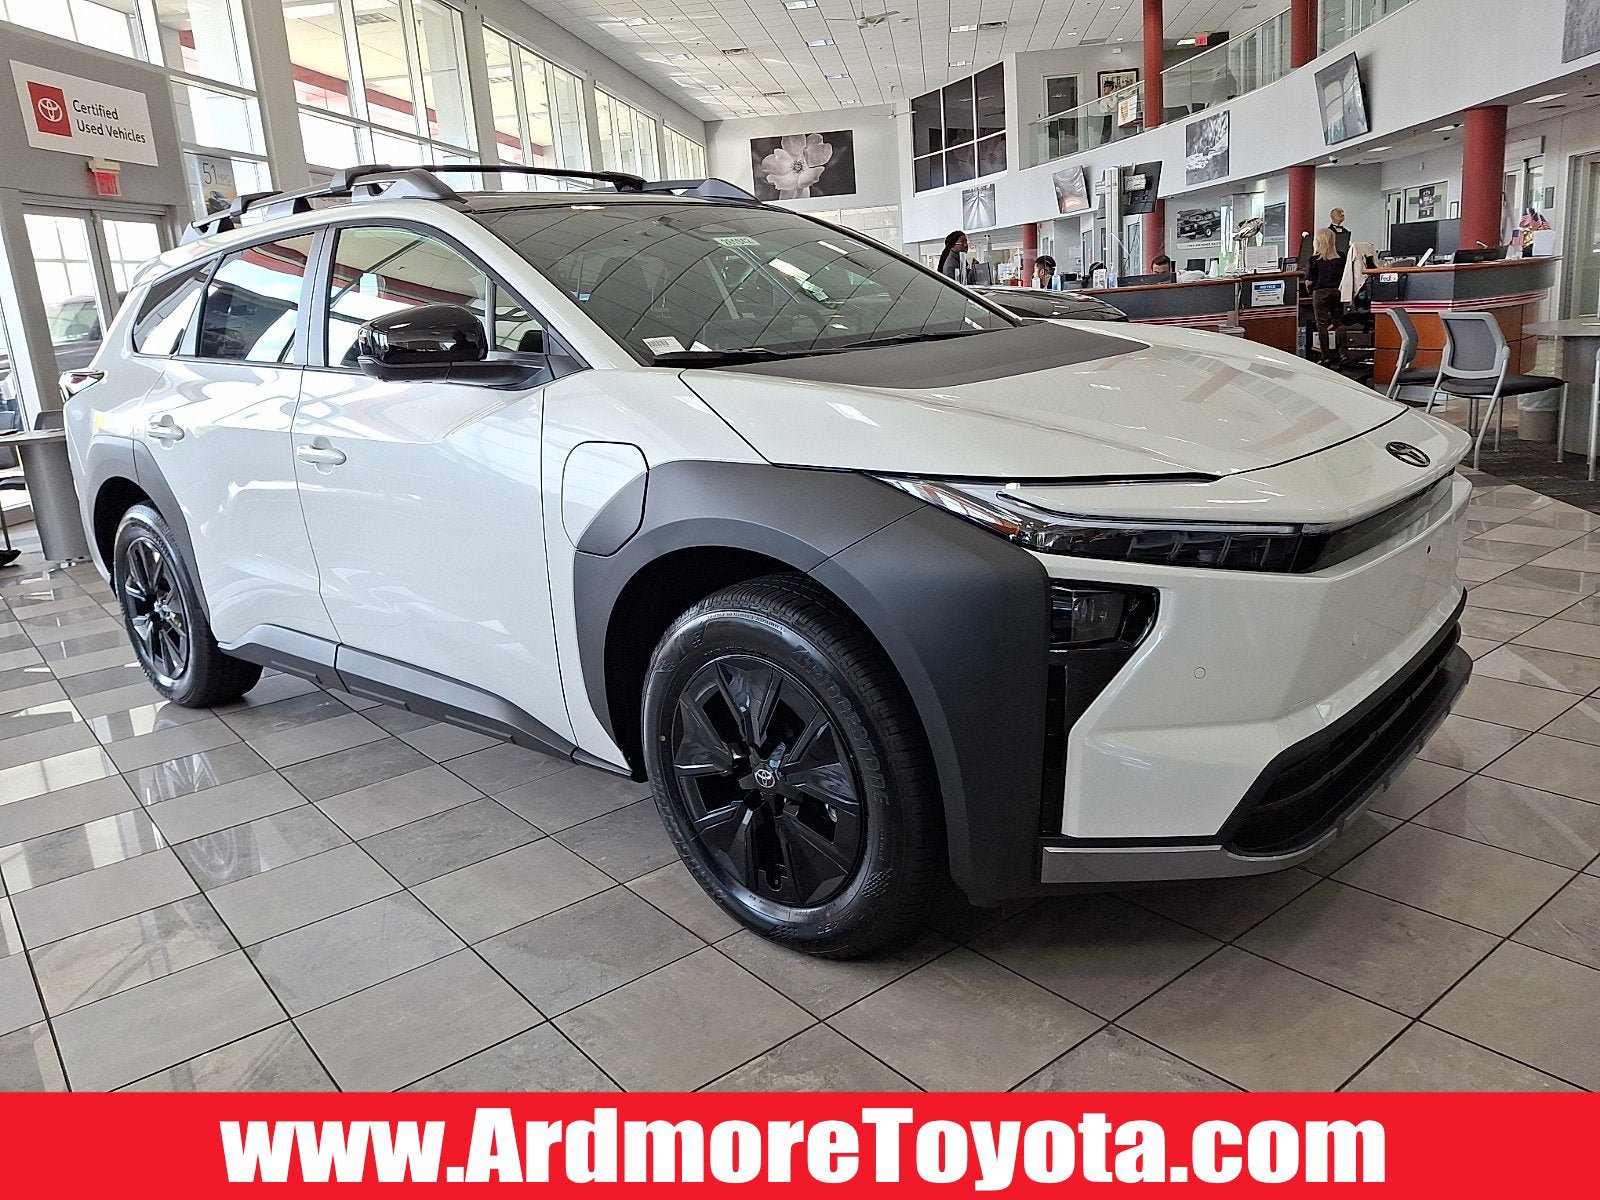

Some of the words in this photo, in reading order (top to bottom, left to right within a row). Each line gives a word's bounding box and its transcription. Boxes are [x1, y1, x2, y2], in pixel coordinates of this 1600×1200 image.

[72, 99, 119, 120] Certified
[76, 118, 104, 136] Used
[105, 124, 146, 144] Vehicles
[202, 162, 218, 185] 51
